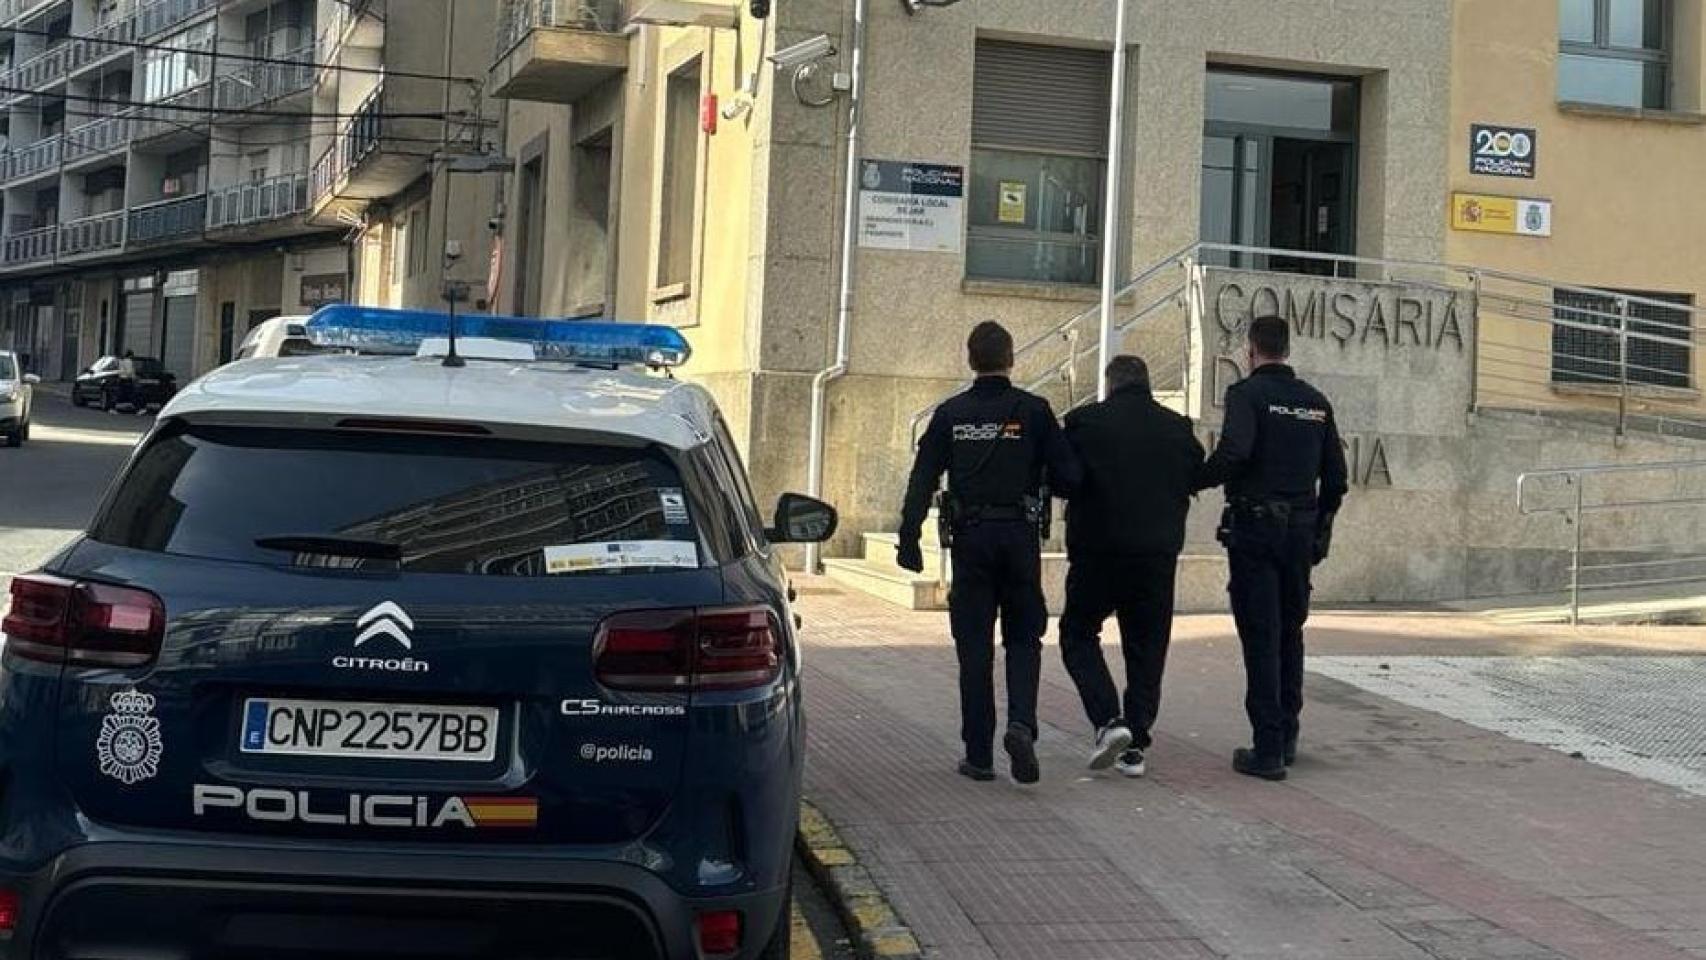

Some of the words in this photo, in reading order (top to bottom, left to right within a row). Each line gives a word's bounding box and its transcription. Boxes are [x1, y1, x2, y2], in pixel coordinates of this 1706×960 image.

[1476, 130, 1531, 157] 200
[1212, 355, 1241, 408] D
[561, 699, 600, 715] C5
[601, 705, 685, 715] AIRCROSS
[268, 707, 489, 753] CNP2257BB
